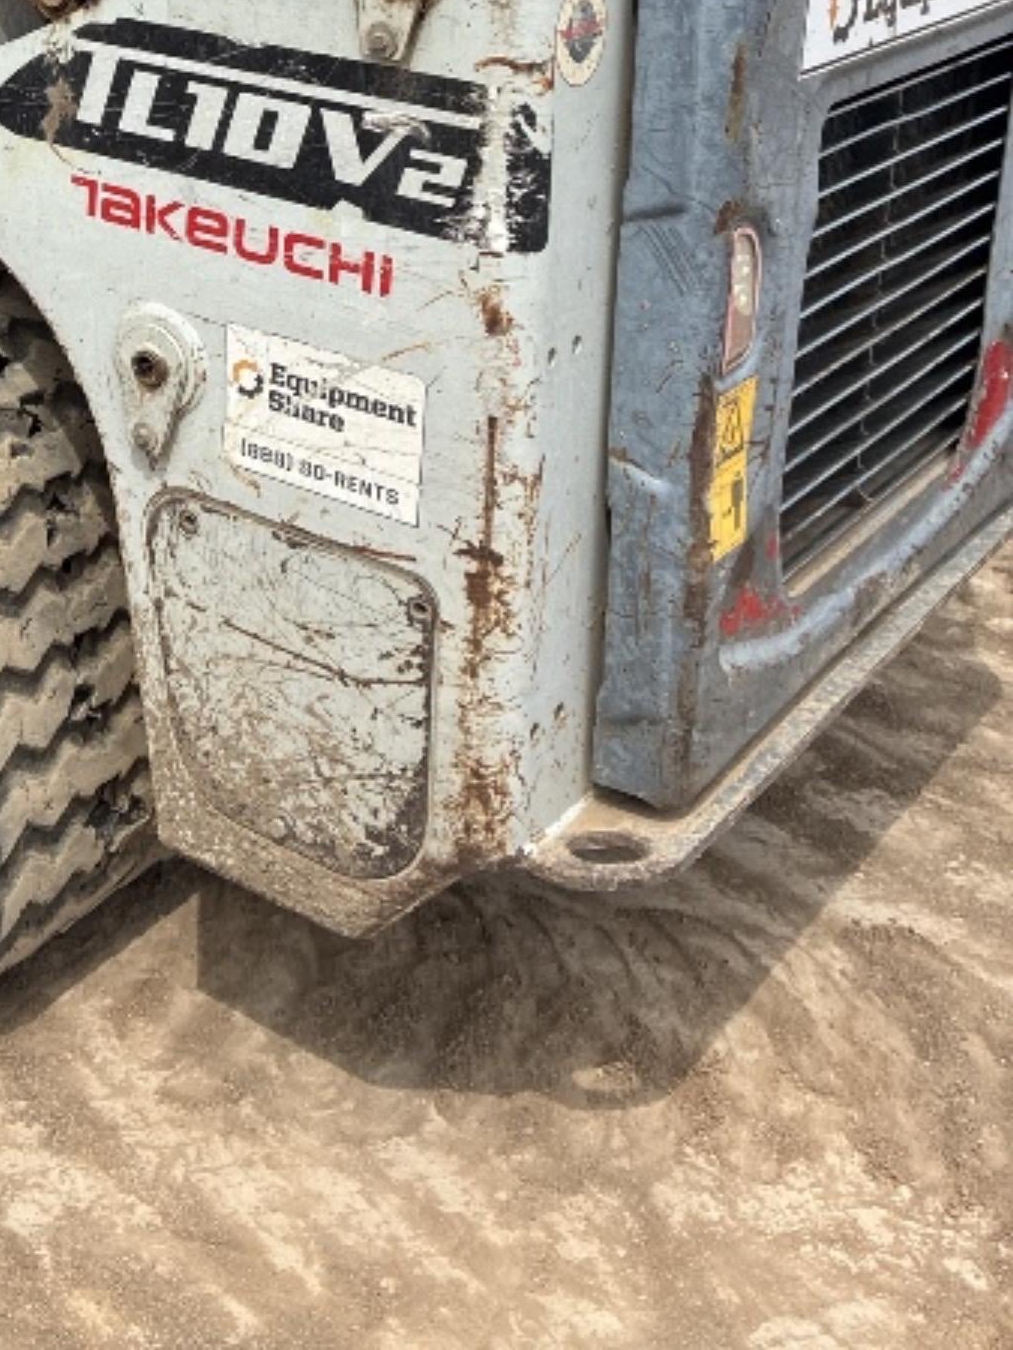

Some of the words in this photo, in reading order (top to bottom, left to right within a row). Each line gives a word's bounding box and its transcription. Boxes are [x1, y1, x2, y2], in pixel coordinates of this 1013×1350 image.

[269, 362, 418, 428] Equipment
[269, 390, 345, 433] Share
[299, 459, 400, 505] 80-RENTS
